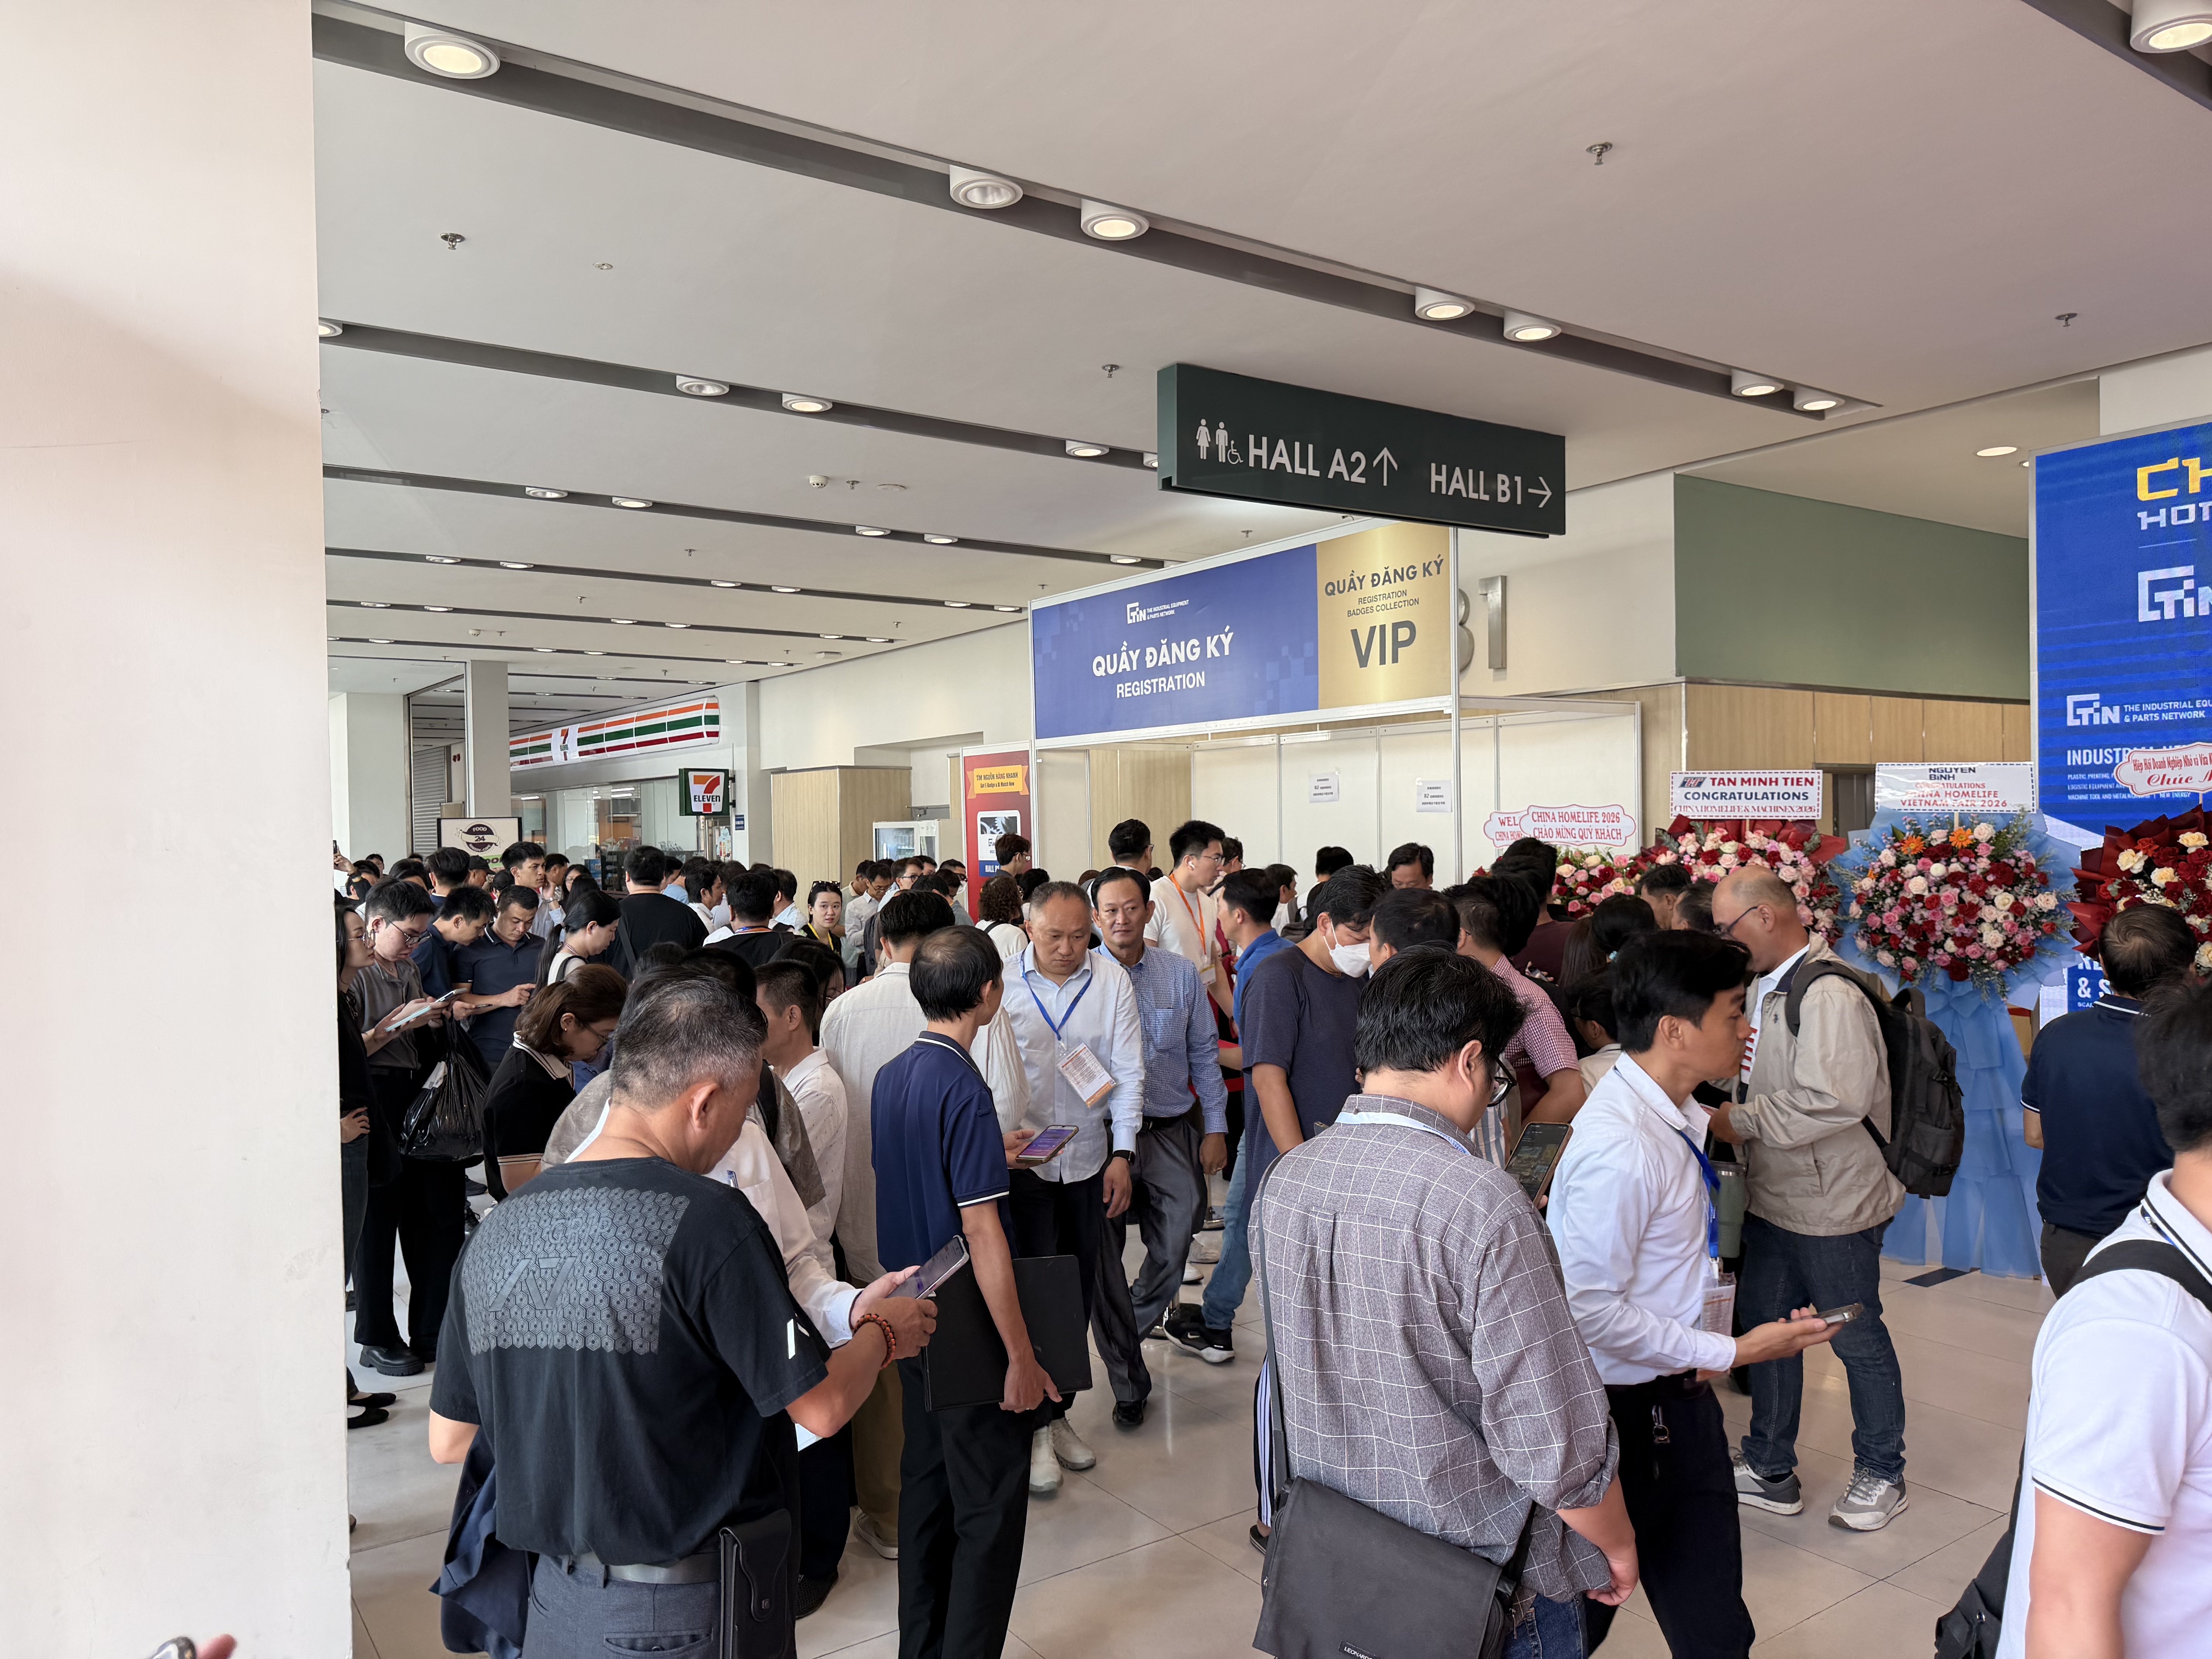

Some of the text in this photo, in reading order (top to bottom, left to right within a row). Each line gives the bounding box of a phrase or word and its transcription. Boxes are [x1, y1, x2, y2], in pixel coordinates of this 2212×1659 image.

[1248, 434, 1366, 484] HALL A2
[1431, 463, 1522, 505] HALL B1
[1325, 554, 1444, 596] QUẦY ĐĂNG KÝ
[1358, 589, 1407, 605] REGISTRATION
[1153, 604, 1170, 612] INDUSTRIAL
[1171, 600, 1189, 608] EQUIPMENT
[1347, 598, 1419, 617] BADGES COLLECTION
[1092, 625, 1233, 677] QUẦY ĐĂNG KÝ
[1350, 620, 1416, 668] VIP
[1117, 671, 1205, 698] REGISTRATION
[2143, 701, 2193, 711] INDUSTRIAL
[2133, 713, 2159, 722] PARTS
[2162, 710, 2205, 720] NETWORK
[1710, 777, 1736, 786] TAN
[1740, 777, 1778, 786] MINH
[1782, 777, 1814, 786] TIEN
[2147, 774, 2193, 787] Chúc
[1684, 792, 1809, 800] CONGRATULATIONS
[1532, 811, 1620, 824] CHINA HOMELIFE 2026
[1533, 824, 1622, 840] CHÀO MỪNG QUÝ KHÁCH
[2078, 977, 2091, 998] &
[548, 1216, 612, 1244] GRIP
